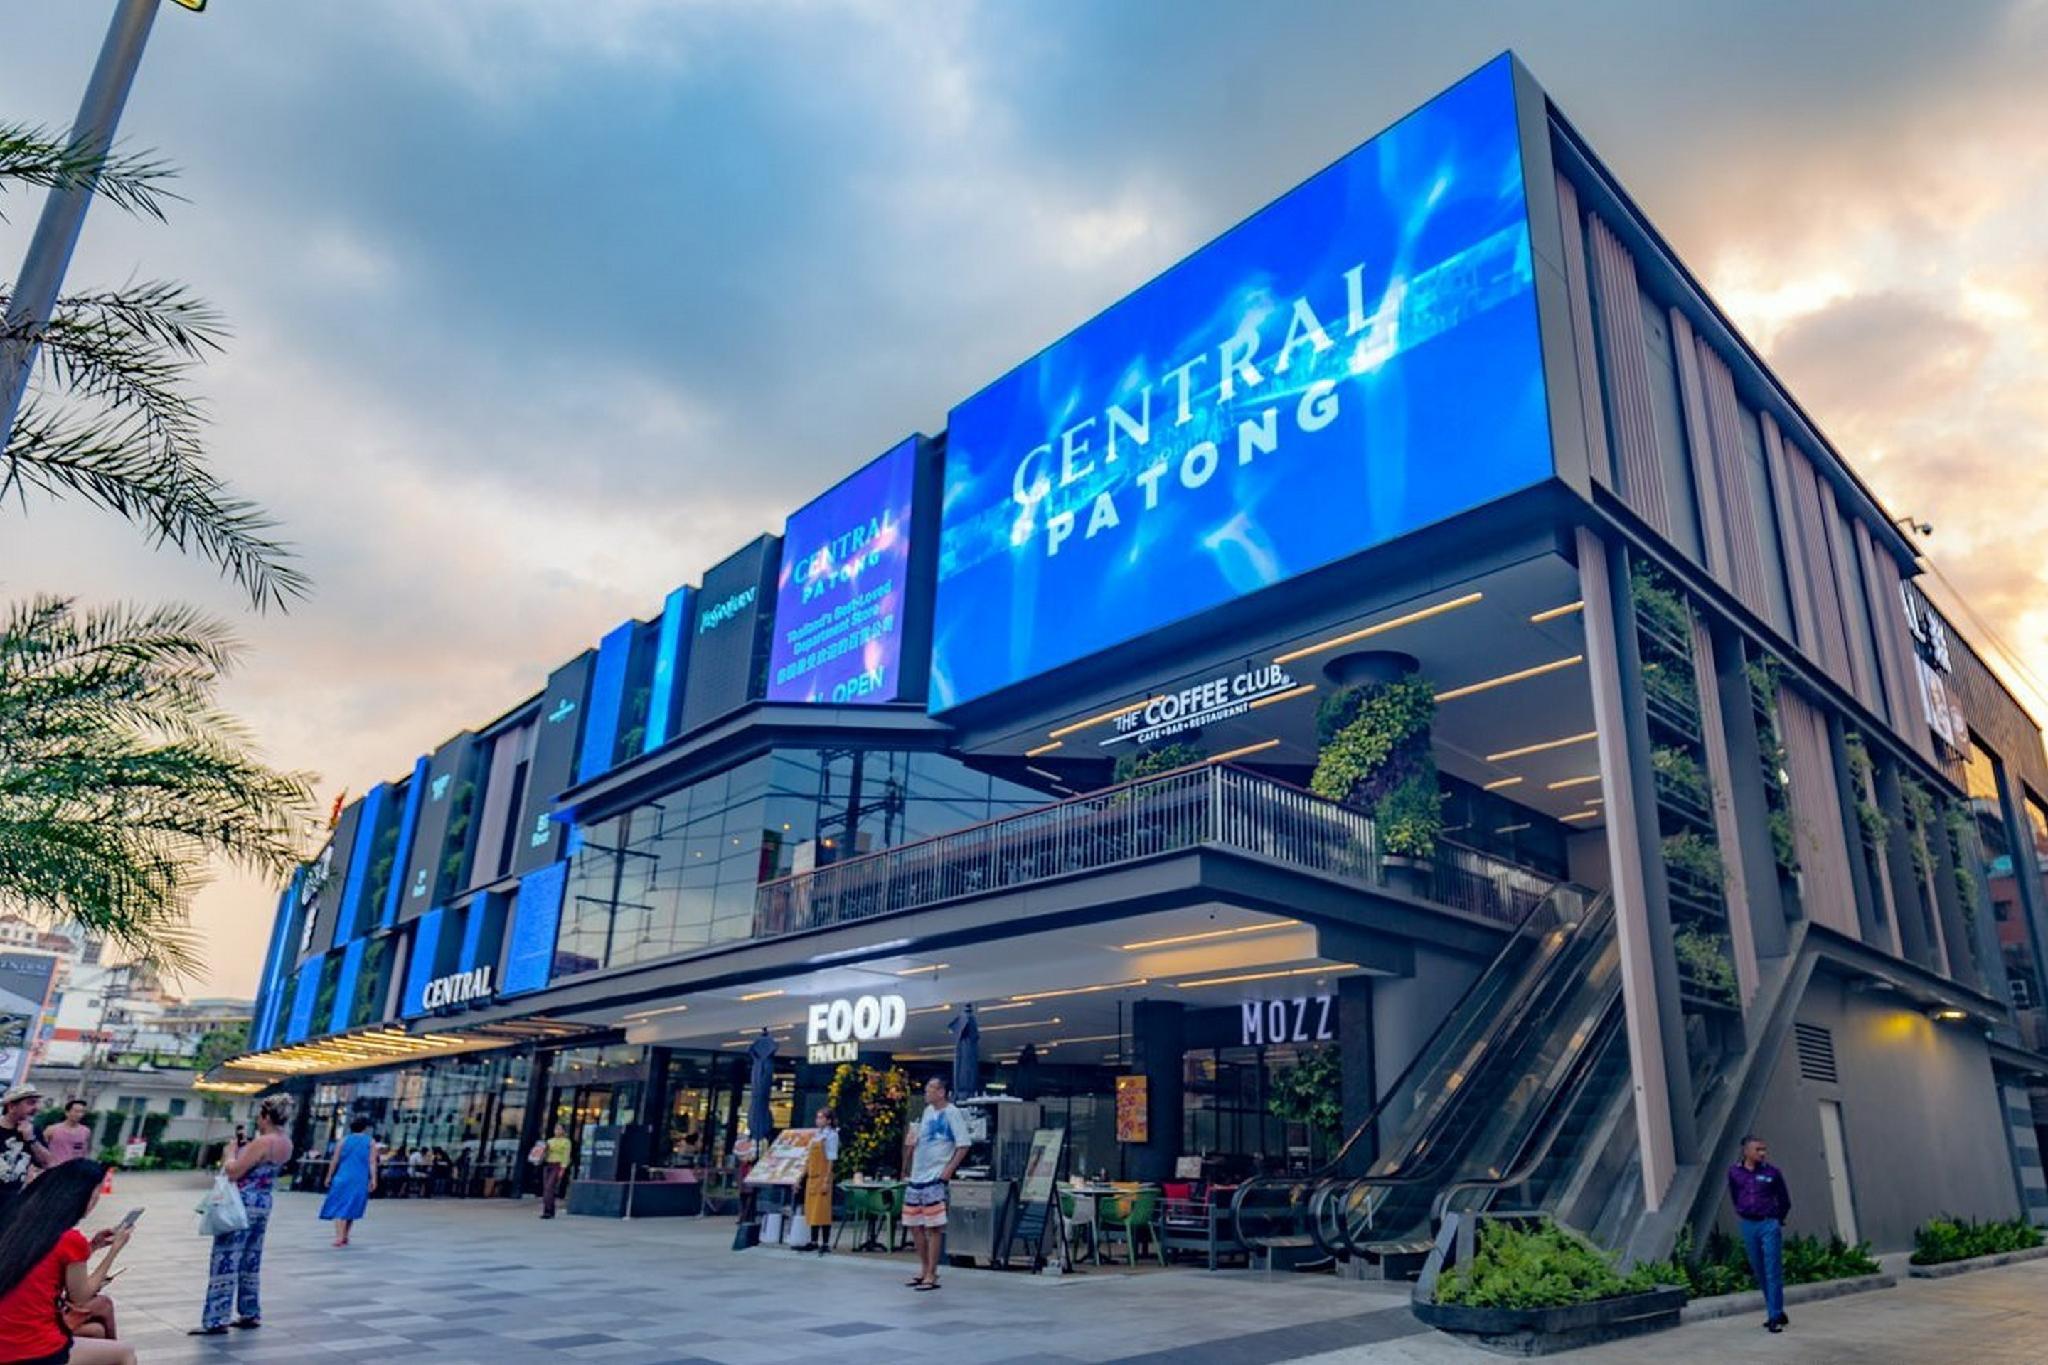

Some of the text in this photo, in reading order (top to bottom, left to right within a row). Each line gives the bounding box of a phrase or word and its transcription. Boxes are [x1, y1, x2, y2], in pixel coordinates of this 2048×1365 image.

[1013, 262, 1390, 502] CENTRAL
[1047, 379, 1339, 556] PATONG
[794, 509, 897, 584] CENTRAL
[802, 551, 880, 604] PATONG
[833, 665, 884, 703] OPEN
[1114, 664, 1282, 732] THE COFFEE CLUB
[1189, 702, 1248, 729] RESTAURANT
[422, 966, 491, 1010] CENTRAL
[807, 995, 906, 1045] FOOD
[1242, 995, 1333, 1045] MOZZ
